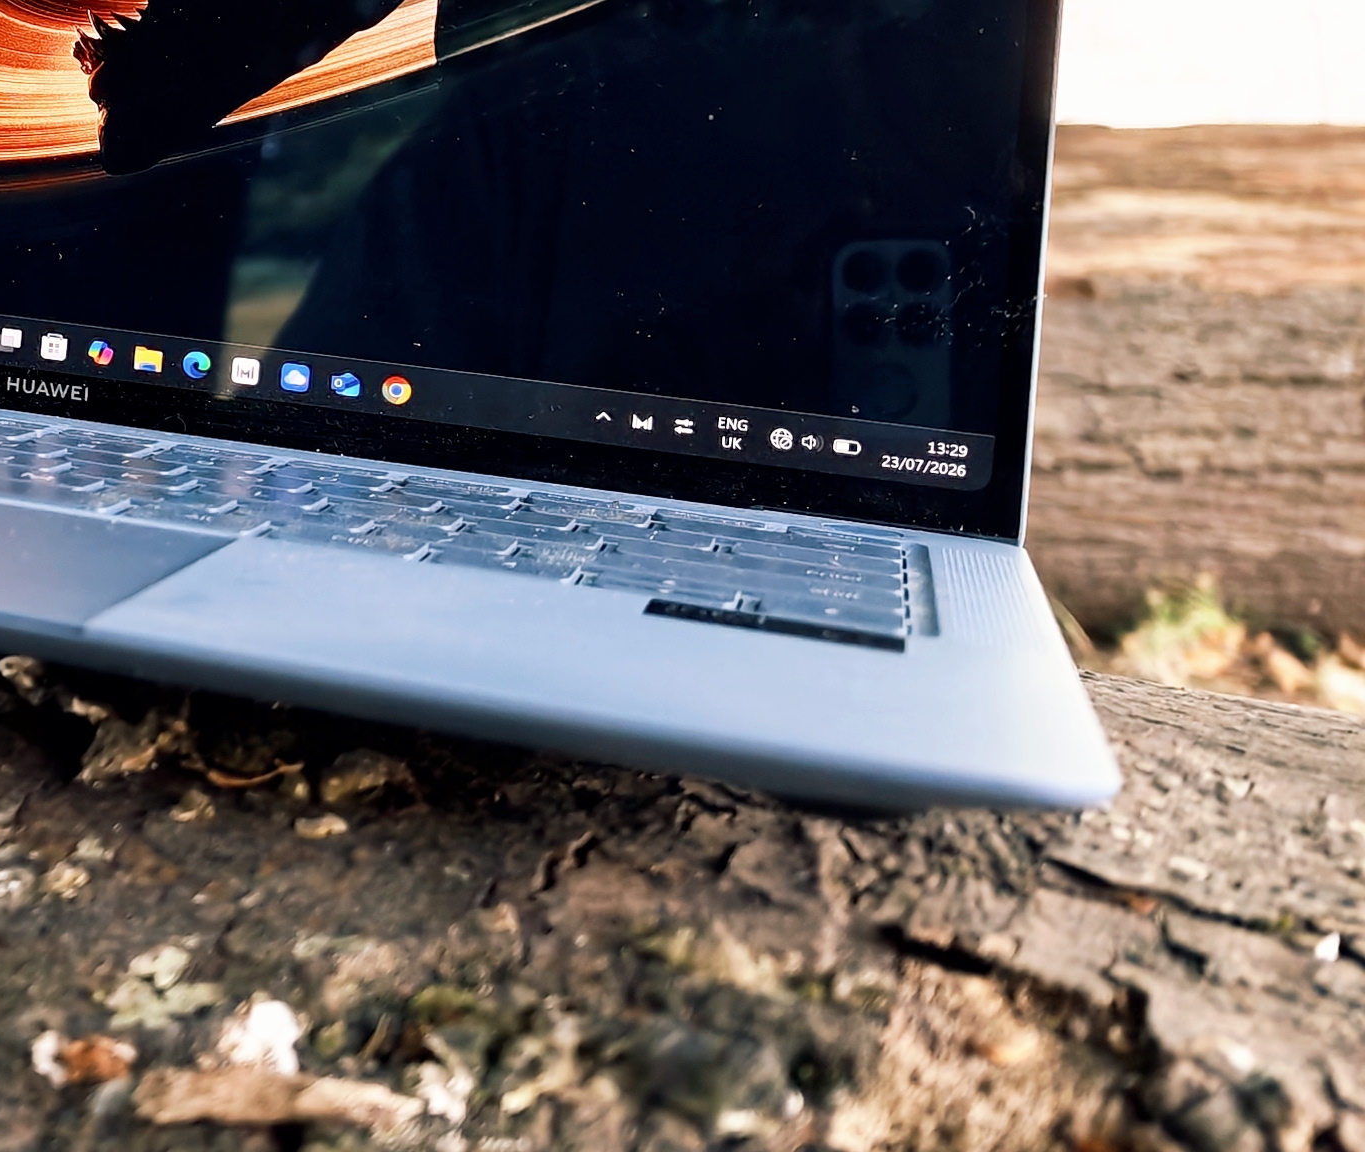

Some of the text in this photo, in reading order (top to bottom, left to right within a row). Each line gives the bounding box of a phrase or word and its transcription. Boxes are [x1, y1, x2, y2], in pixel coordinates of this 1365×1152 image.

[6, 376, 89, 402] HUAWEI
[717, 415, 749, 432] ENG
[721, 435, 742, 450] UK
[927, 441, 968, 457] 13:29
[881, 455, 967, 477] 23/07/2026
